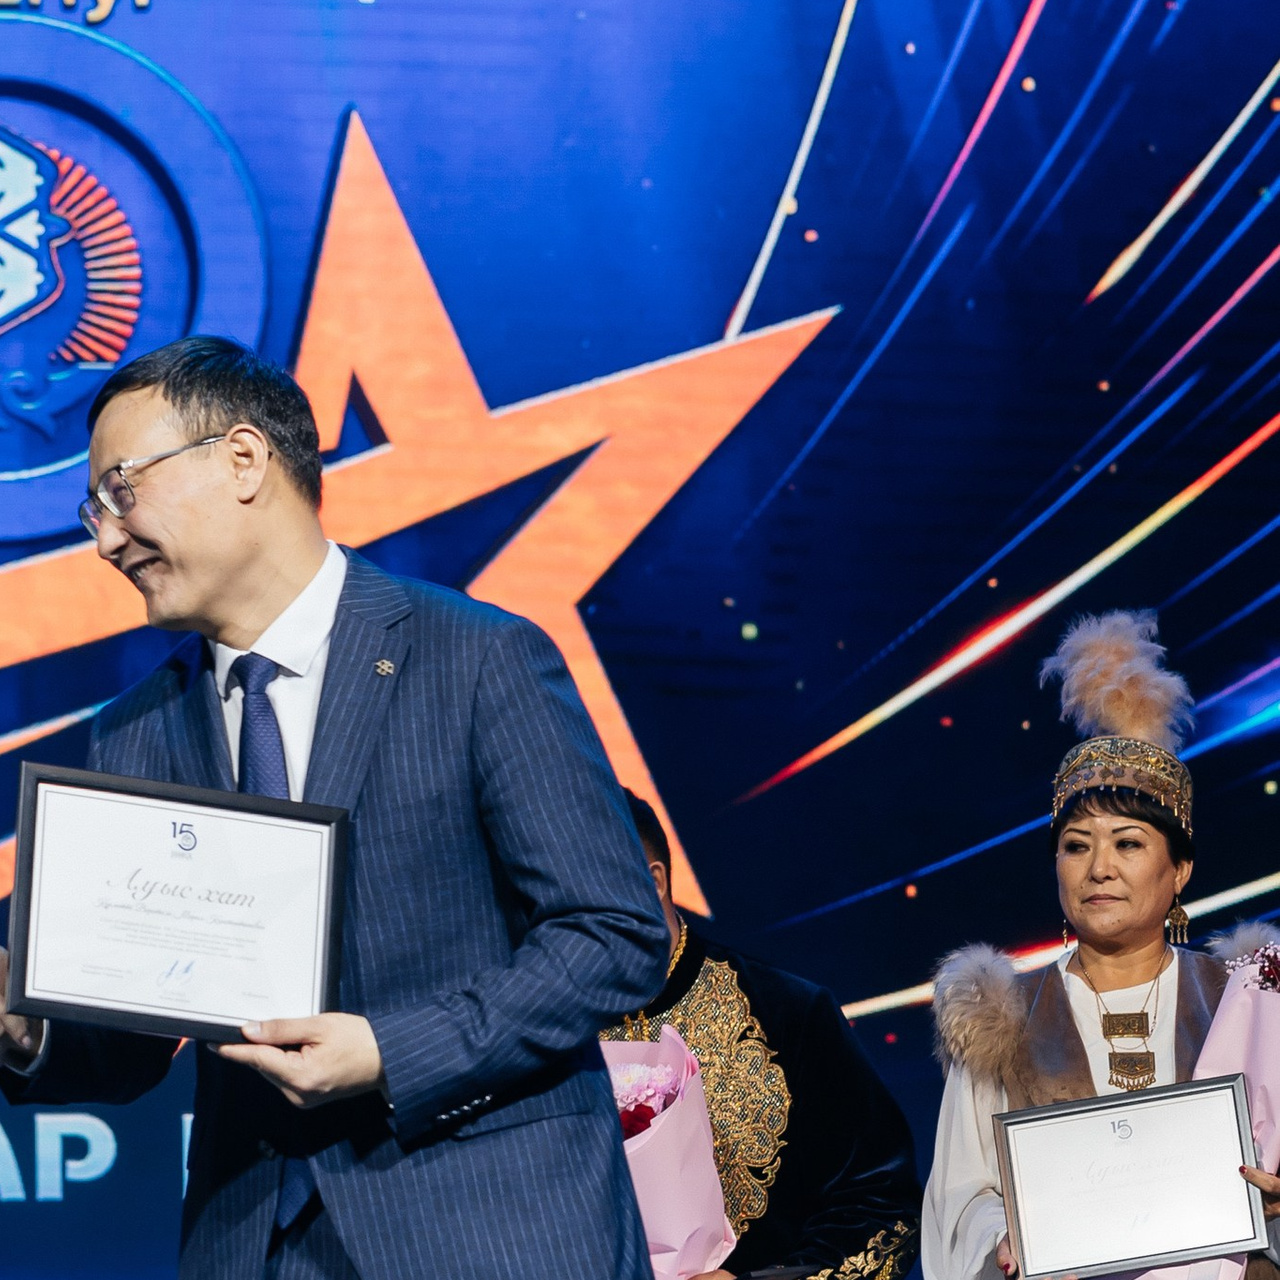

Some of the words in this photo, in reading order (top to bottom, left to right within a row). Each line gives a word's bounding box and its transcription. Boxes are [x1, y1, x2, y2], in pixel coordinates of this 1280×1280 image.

[171, 821, 198, 852] 15
[198, 888, 256, 908] хат
[1110, 1119, 1133, 1140] 15
